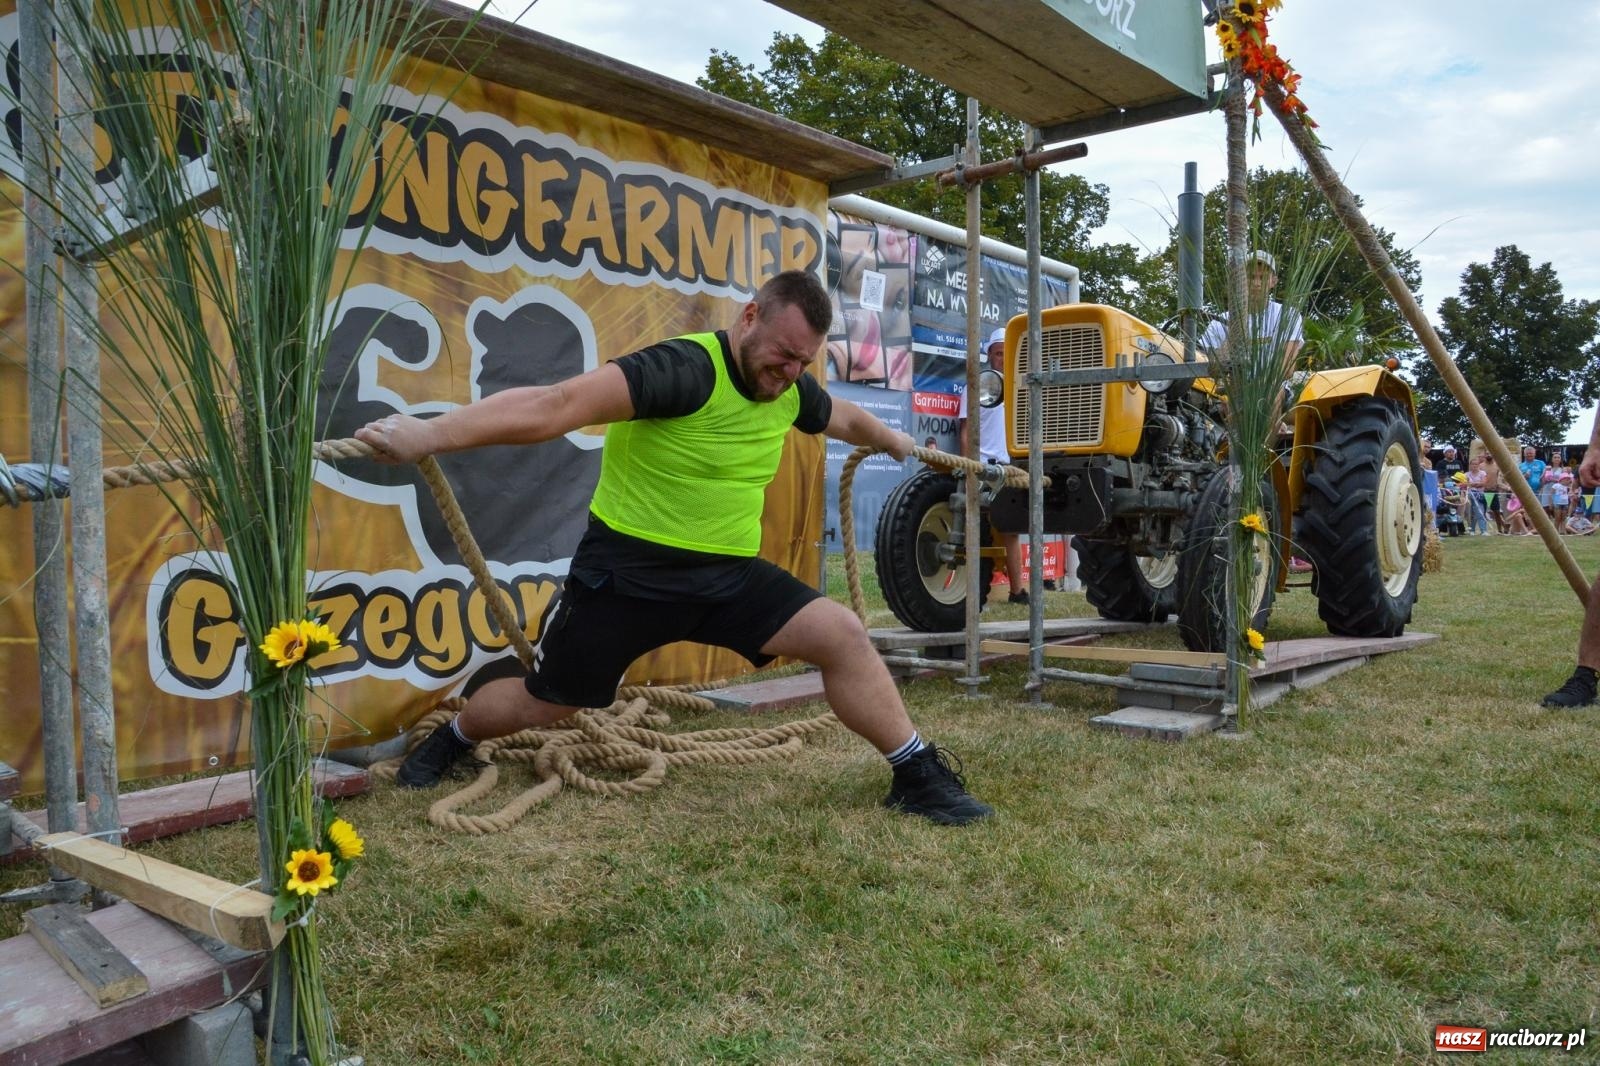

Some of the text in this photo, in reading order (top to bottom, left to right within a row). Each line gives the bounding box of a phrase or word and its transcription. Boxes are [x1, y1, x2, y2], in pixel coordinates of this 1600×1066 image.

[927, 288, 945, 309] NA
[914, 392, 959, 413] Garnitury
[917, 416, 957, 437] MODA
[163, 574, 566, 683] Gzegor
